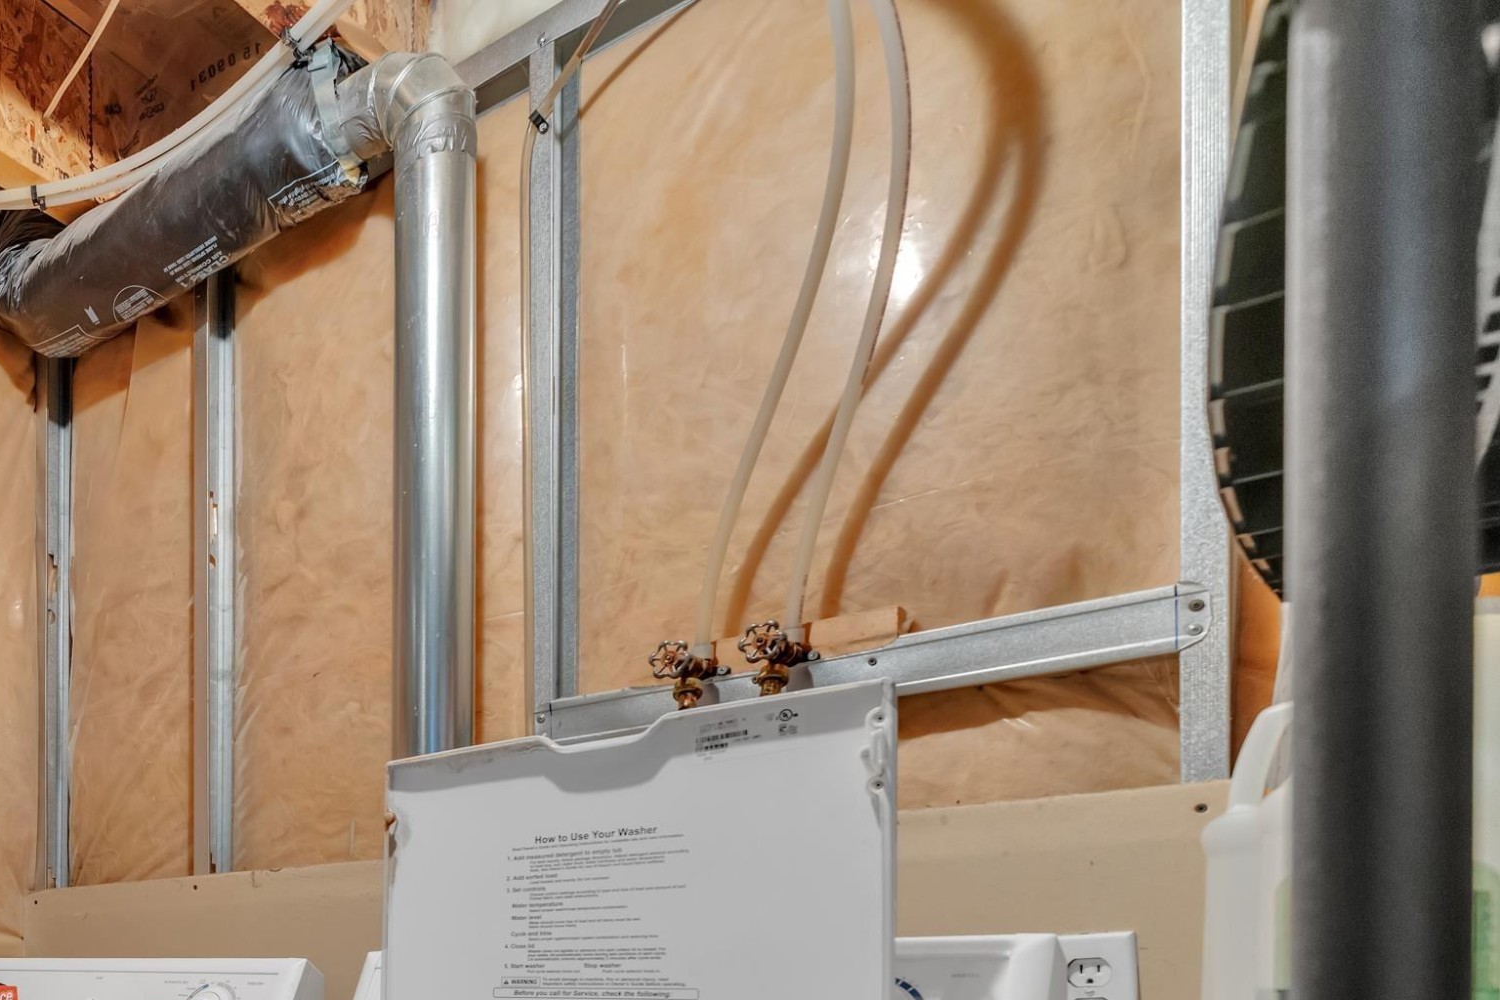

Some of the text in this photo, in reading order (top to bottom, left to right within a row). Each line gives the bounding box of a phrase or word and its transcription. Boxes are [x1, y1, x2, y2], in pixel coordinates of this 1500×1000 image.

[534, 836, 556, 844] How
[570, 833, 590, 841] Use
[592, 830, 615, 839] Your
[618, 826, 658, 837] Washer
